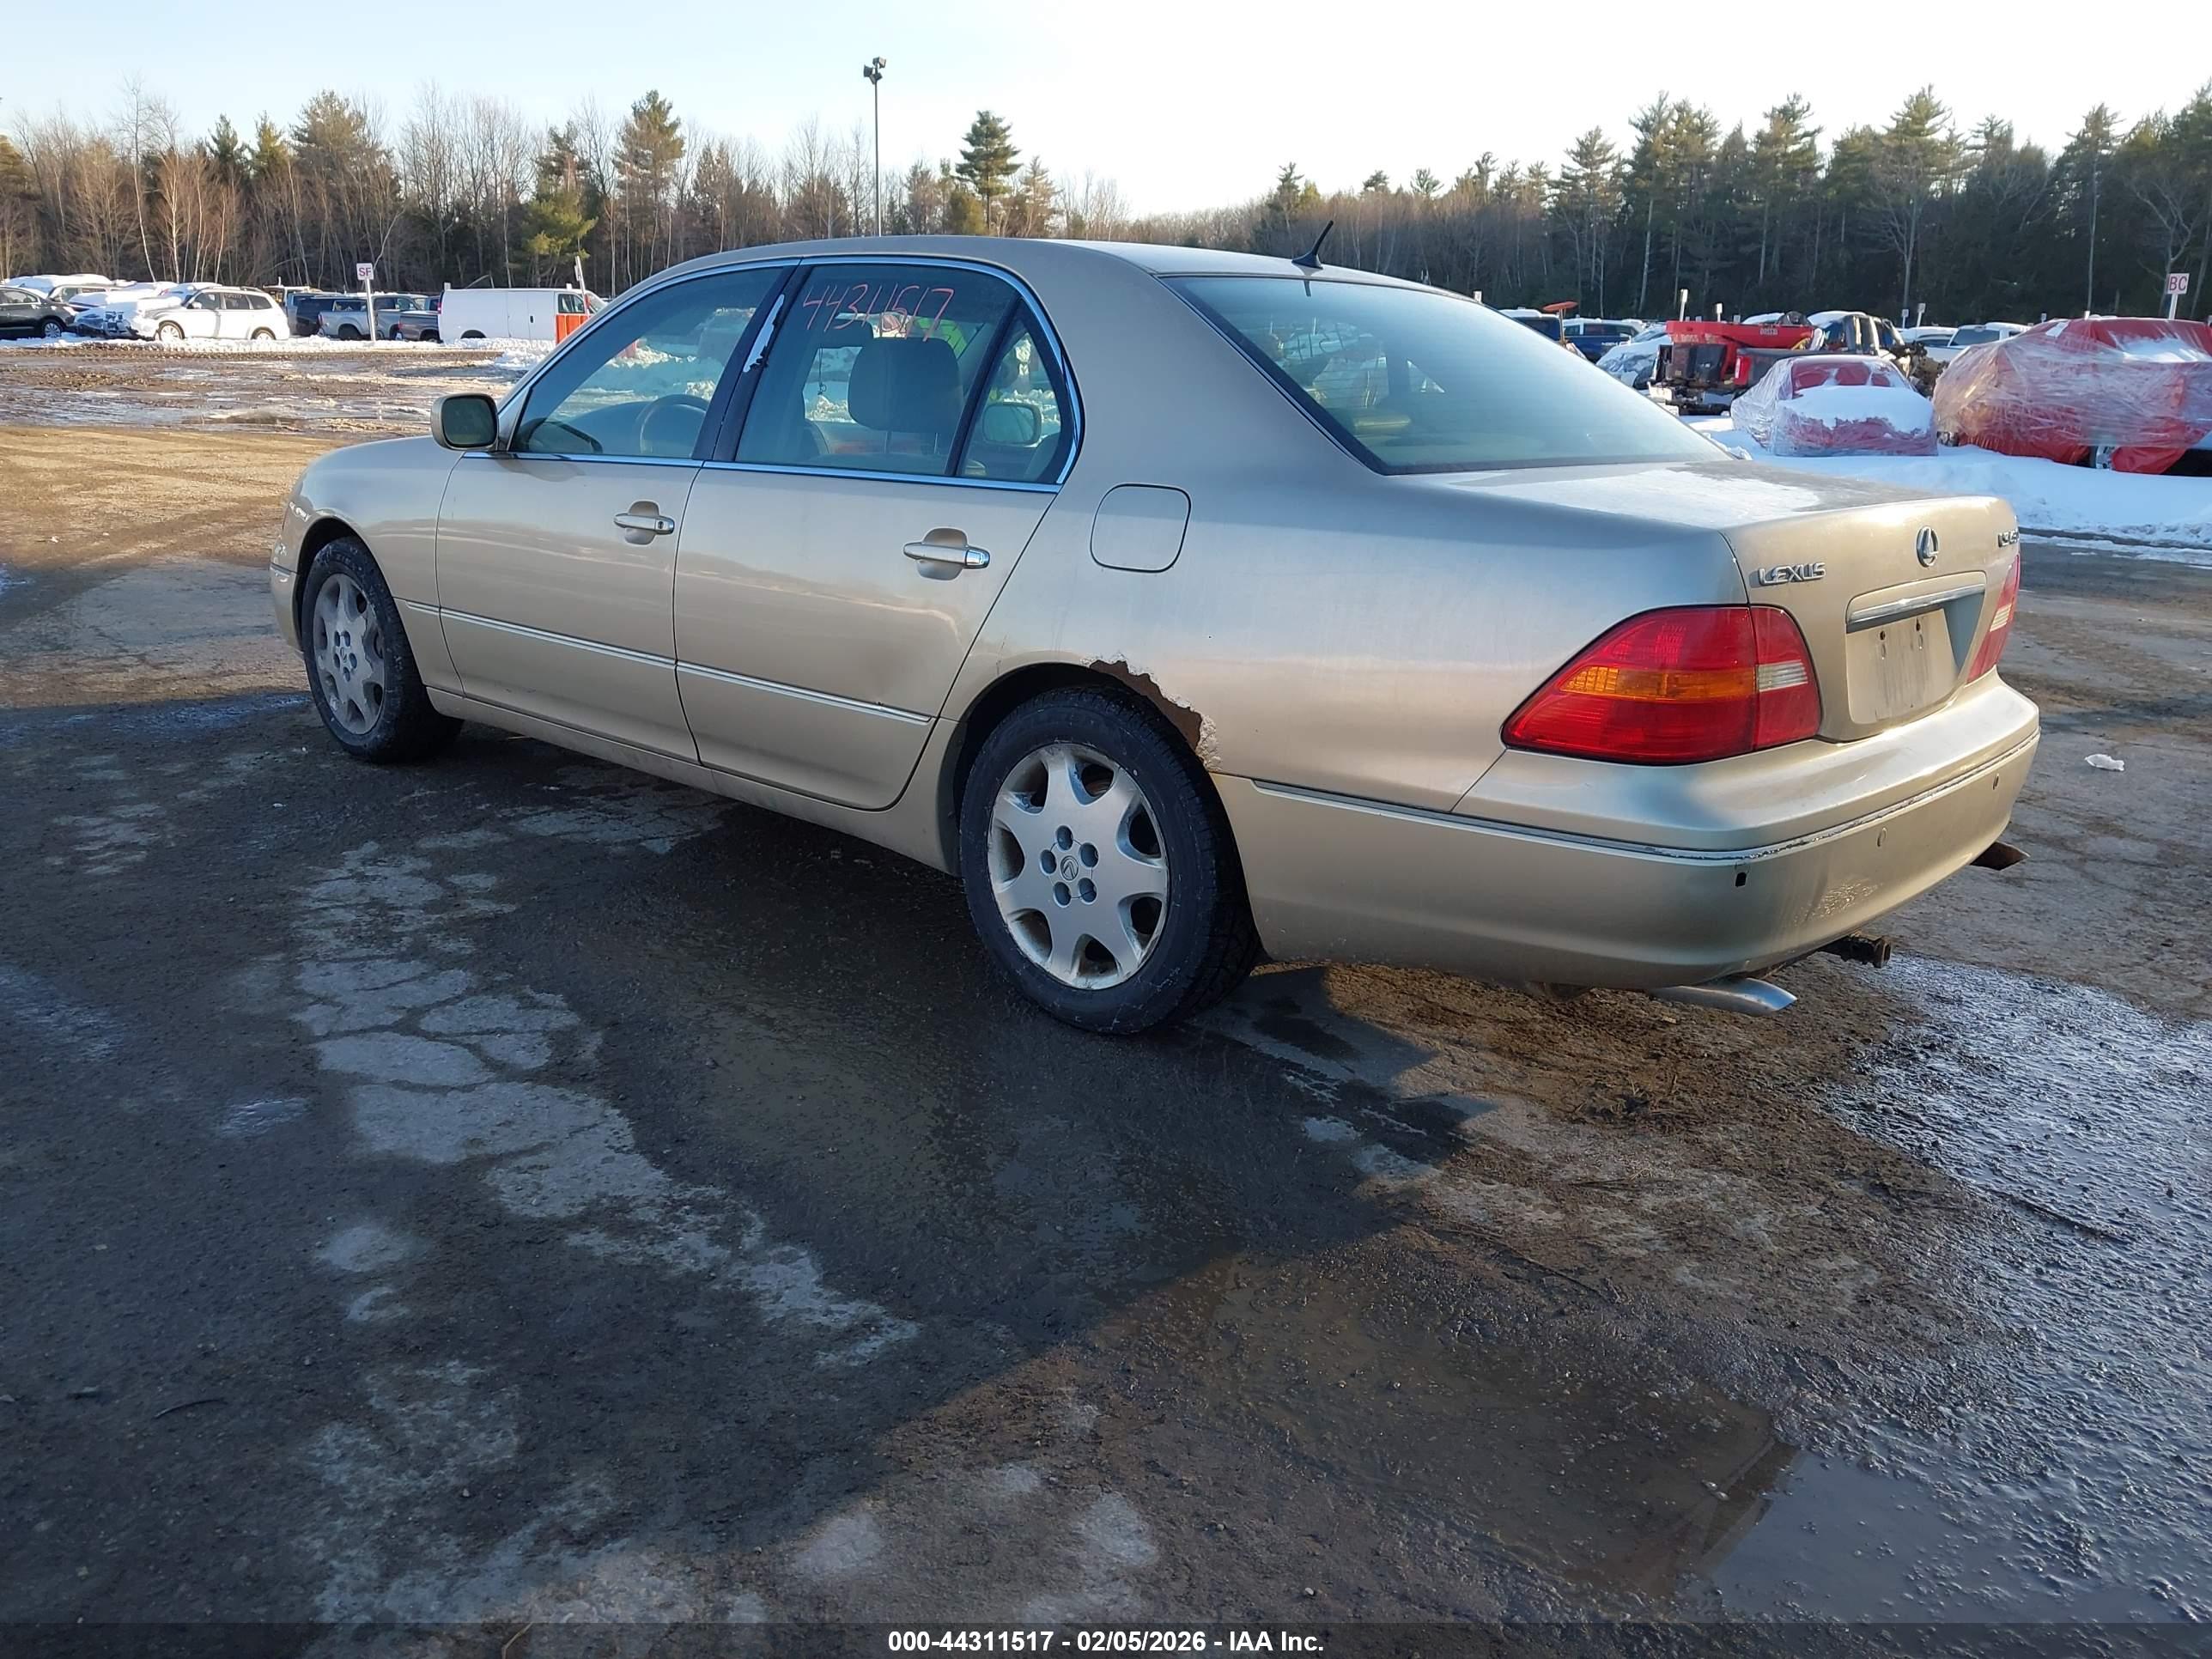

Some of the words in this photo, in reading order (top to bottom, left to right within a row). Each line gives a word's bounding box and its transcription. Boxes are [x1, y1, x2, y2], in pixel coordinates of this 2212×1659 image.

[358, 267, 372, 276] SF
[2169, 276, 2188, 291] BC
[802, 283, 955, 342] 44311517
[1758, 562, 1826, 586] LEXUS
